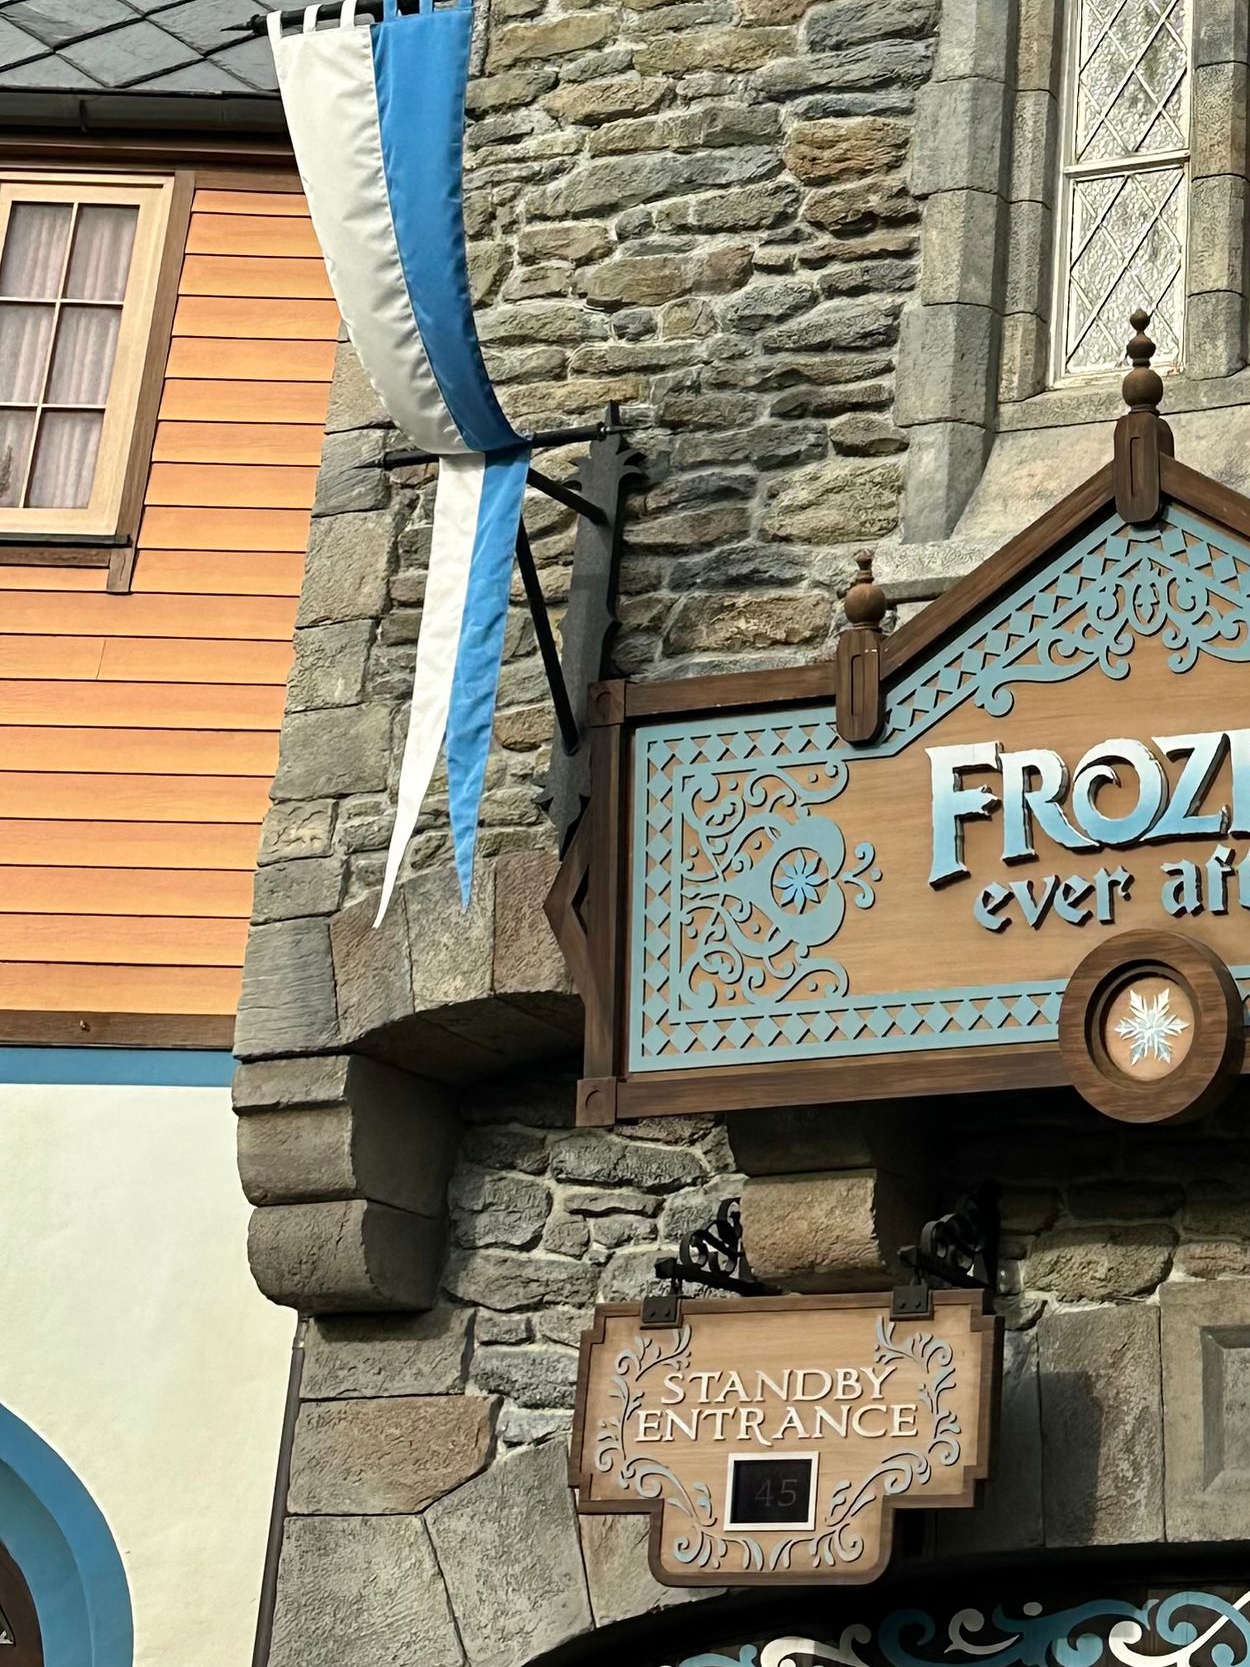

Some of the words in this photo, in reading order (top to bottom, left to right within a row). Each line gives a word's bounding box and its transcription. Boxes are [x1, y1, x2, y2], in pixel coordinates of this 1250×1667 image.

[973, 865, 1134, 931] ever
[661, 1366, 896, 1405] STANDBY
[634, 1404, 919, 1446] ENTRANCE
[755, 1479, 798, 1507] 45
